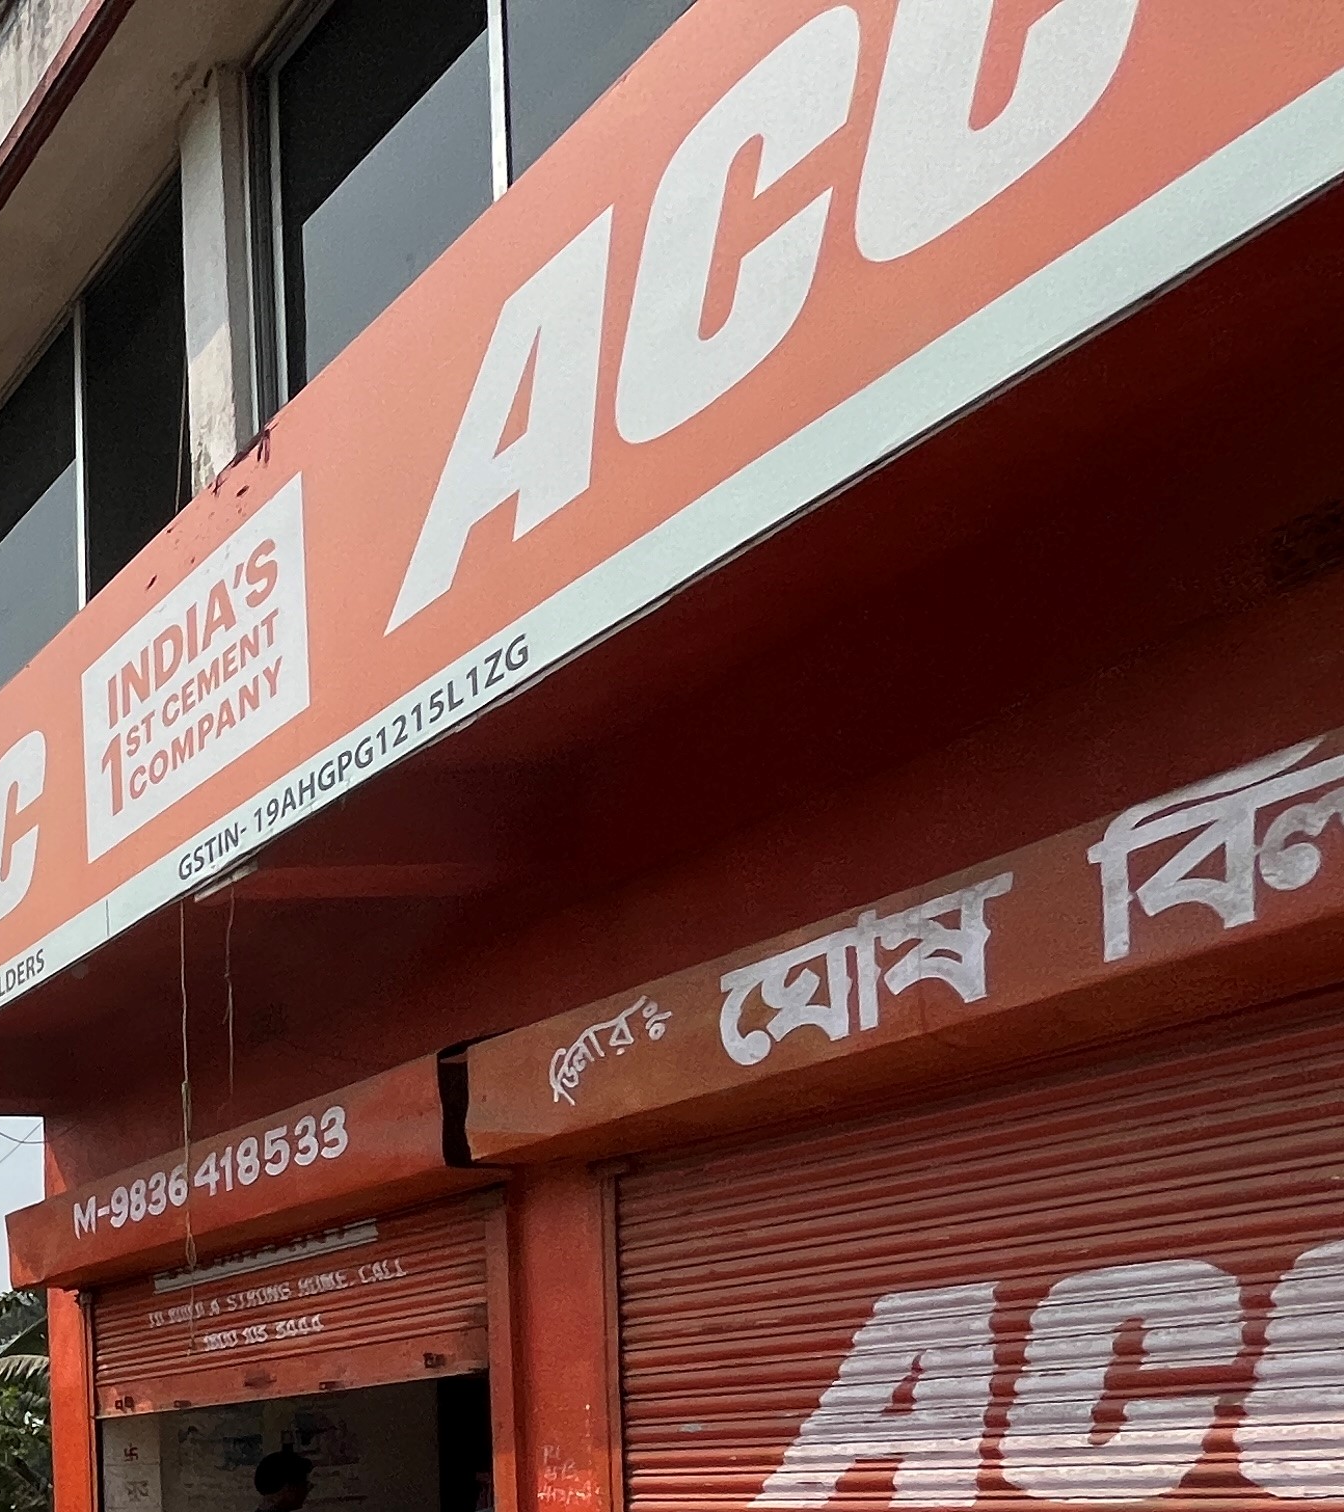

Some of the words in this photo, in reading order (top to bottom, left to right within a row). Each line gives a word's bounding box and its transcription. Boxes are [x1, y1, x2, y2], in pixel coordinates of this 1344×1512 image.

[383, 0, 1140, 638] ACC
[106, 537, 279, 731] INDIA'S
[129, 655, 283, 801] COMPANY
[161, 607, 280, 729] CEMENT
[178, 821, 248, 881] GSTIN-
[253, 633, 530, 833] 19AHGPG1215L1ZG
[719, 871, 1014, 1066] ঘোষ
[357, 1257, 408, 1285] CALL
